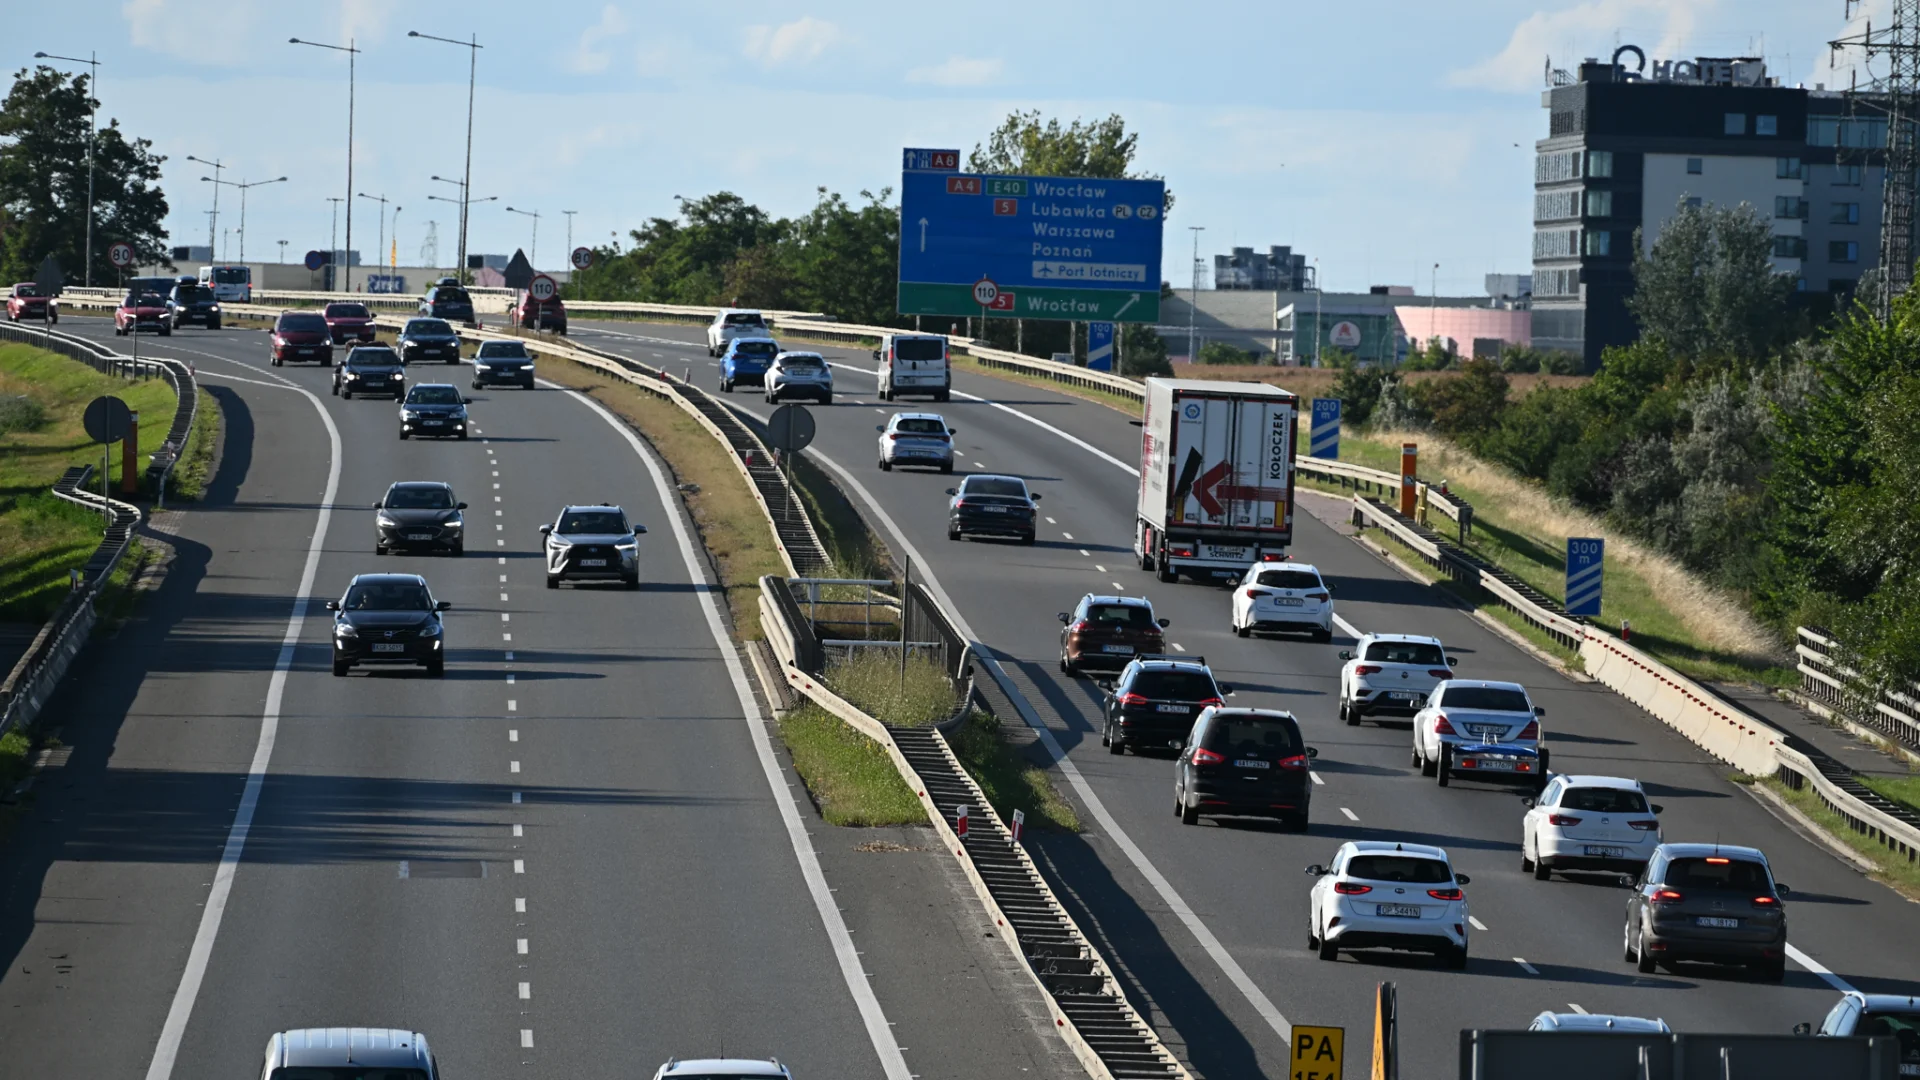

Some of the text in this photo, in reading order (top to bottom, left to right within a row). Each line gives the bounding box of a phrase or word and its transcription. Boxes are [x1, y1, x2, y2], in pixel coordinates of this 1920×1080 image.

[1652, 59, 1753, 84] HOTEL
[934, 154, 954, 167] A8
[954, 177, 975, 193] A4
[1033, 181, 1107, 199] Wrocław
[1001, 202, 1010, 213] 5
[1032, 202, 1154, 218] Lubawka PL CZ
[1032, 222, 1116, 240] Warszawa
[113, 249, 129, 260] 80
[1032, 242, 1093, 258] Poznań
[574, 253, 591, 264] 80
[1058, 266, 1140, 280] Port lotniczy
[533, 283, 553, 294] 110
[977, 287, 996, 299] 110
[998, 295, 1006, 307] 5
[1027, 296, 1100, 313] Wrocław
[1094, 323, 1110, 332] 100
[1316, 401, 1337, 412] 200
[1321, 412, 1331, 420] m
[1270, 412, 1284, 480] KOŁOCZEK
[1572, 541, 1598, 554] 300
[1209, 551, 1245, 559] SCHMITZ
[1579, 556, 1590, 564] m
[1395, 907, 1419, 916] 5441N
[1296, 1034, 1336, 1061] PA
